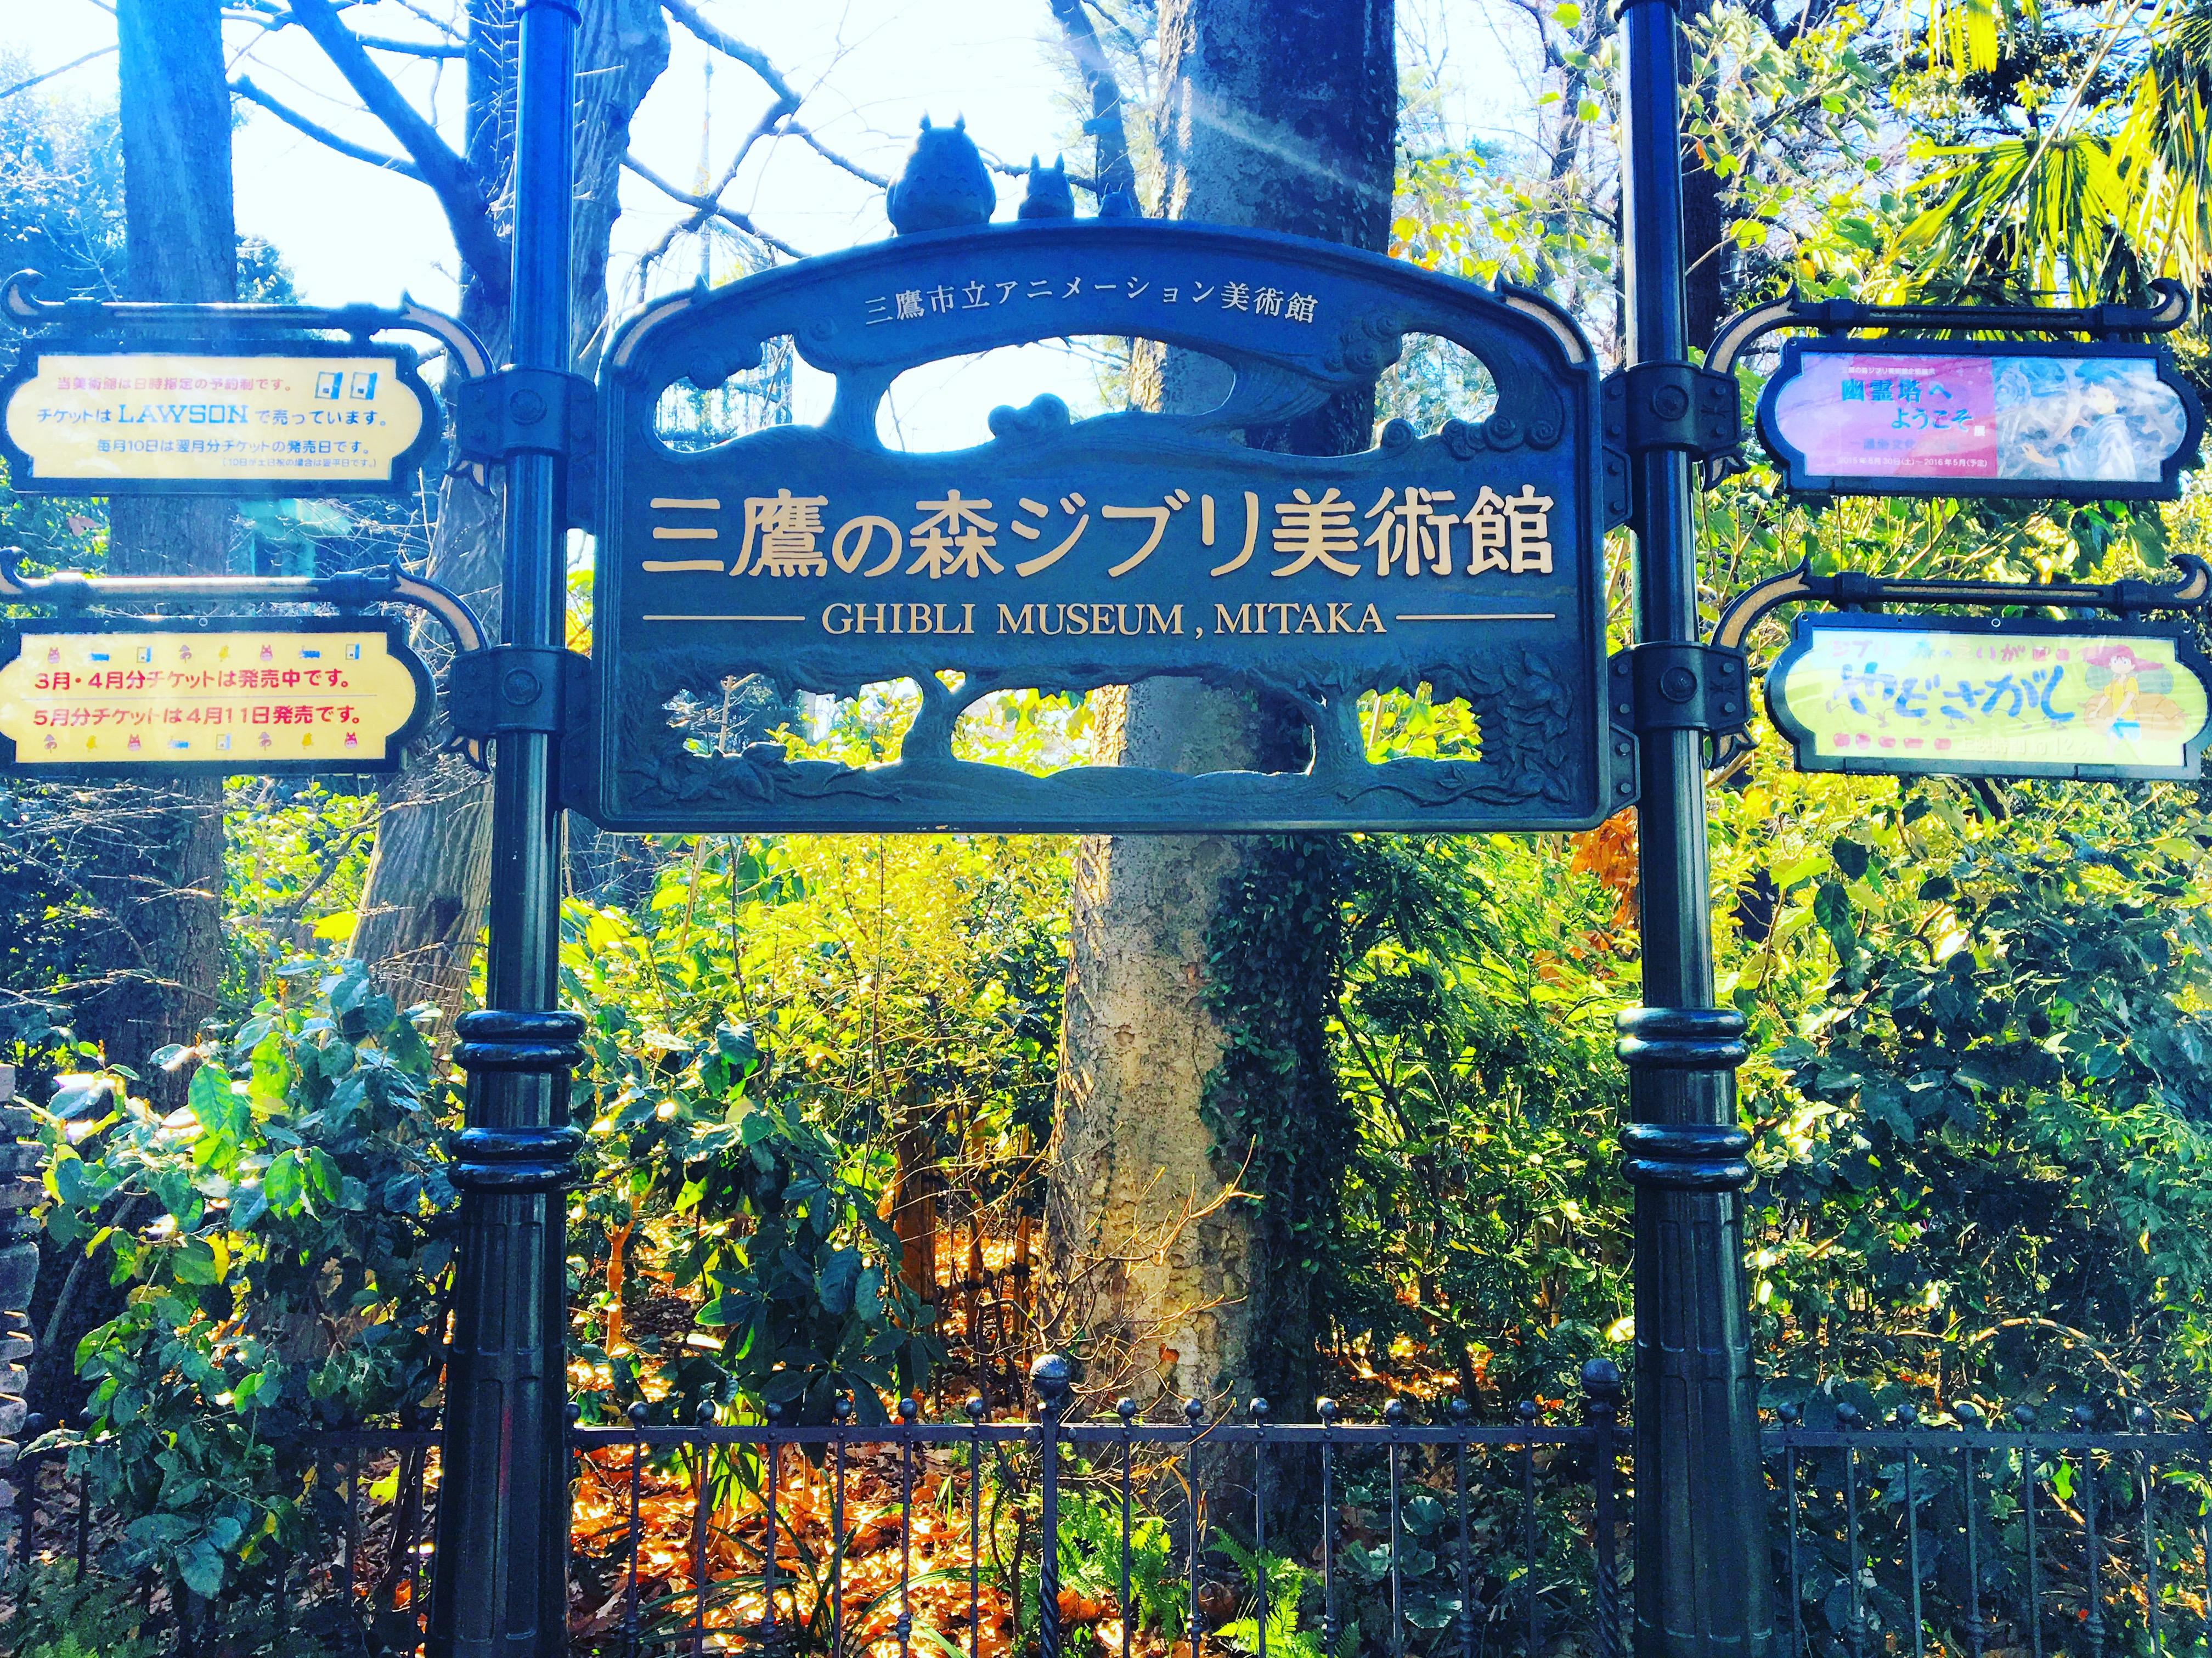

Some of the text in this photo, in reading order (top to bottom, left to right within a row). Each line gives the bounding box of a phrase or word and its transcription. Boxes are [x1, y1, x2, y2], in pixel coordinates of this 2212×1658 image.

[865, 276, 1318, 324] 三鷹市立アニメーション美術館
[57, 377, 291, 391] 当美術館は日時指定の予約制です。
[1841, 379, 1953, 403] 幽霊塔へ
[37, 404, 386, 426] チケットは LAWSON で売っています。
[97, 439, 369, 454] 毎月10日は翌月分チケットの発売日です。
[642, 483, 1555, 579] 三鷹の森ジブリ美術館
[822, 602, 975, 634] GHIBLI
[1214, 602, 1387, 634] MITAKA
[34, 668, 349, 691] 3月・4月分チケットは発売中です。
[33, 705, 360, 727] 5月分チケットは4月11日発売です。
